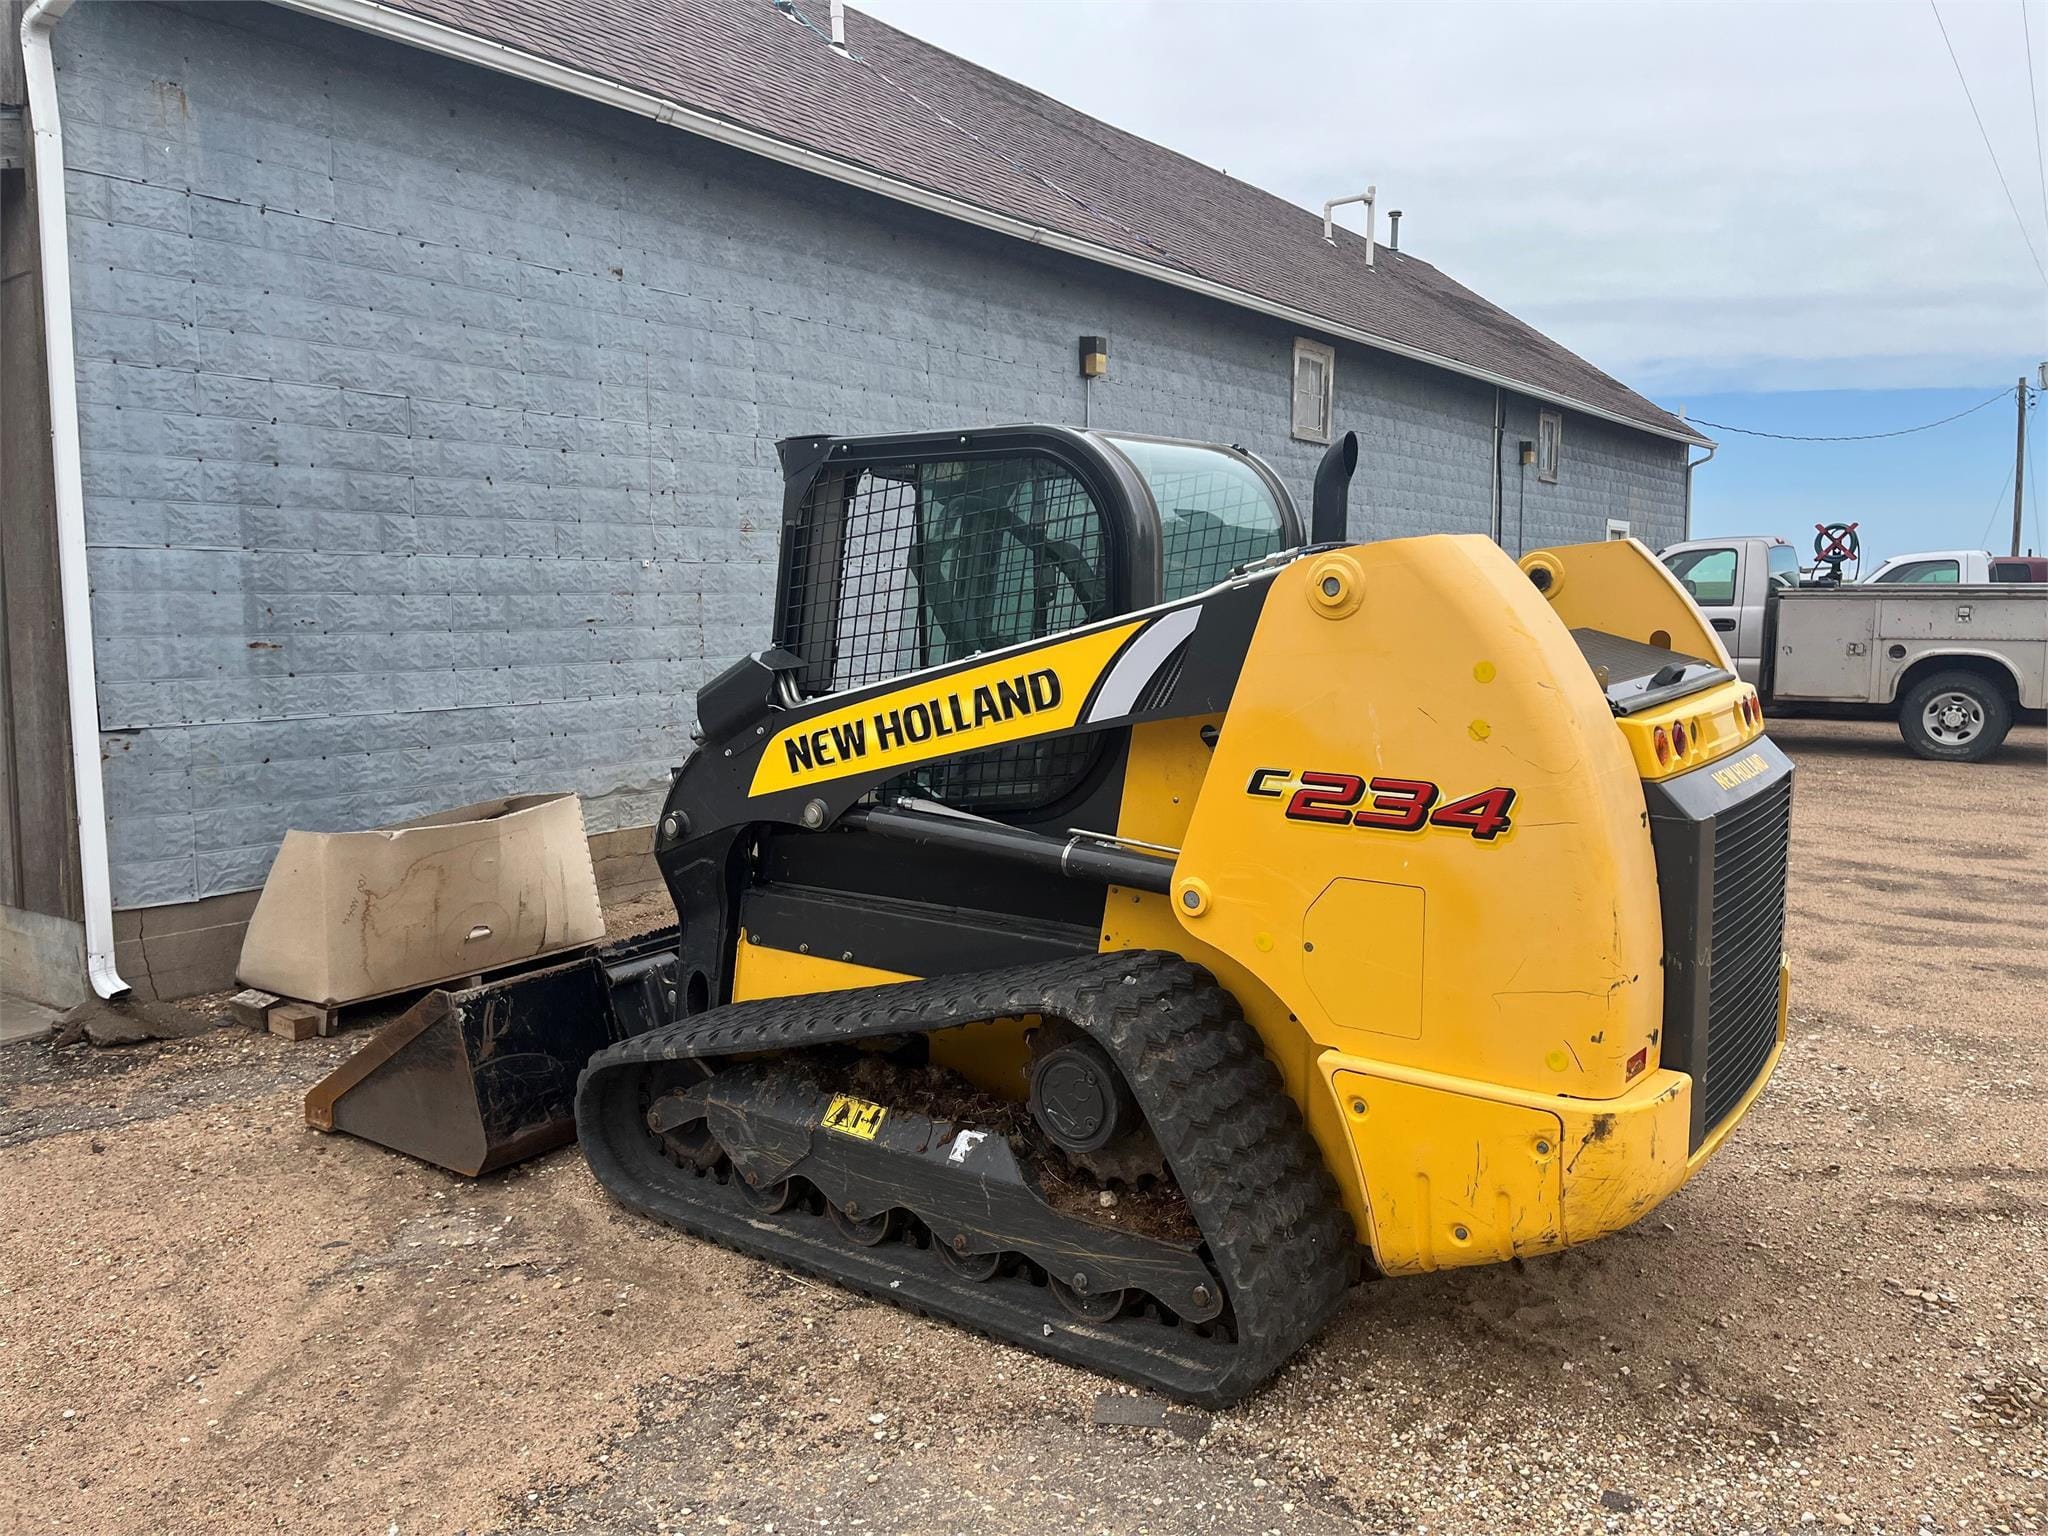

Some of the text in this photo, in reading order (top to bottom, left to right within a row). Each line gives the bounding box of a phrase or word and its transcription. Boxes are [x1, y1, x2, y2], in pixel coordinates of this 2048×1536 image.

[784, 667, 1063, 774] NEW HOLLAND
[1711, 753, 1769, 791] NEW HOLLAND
